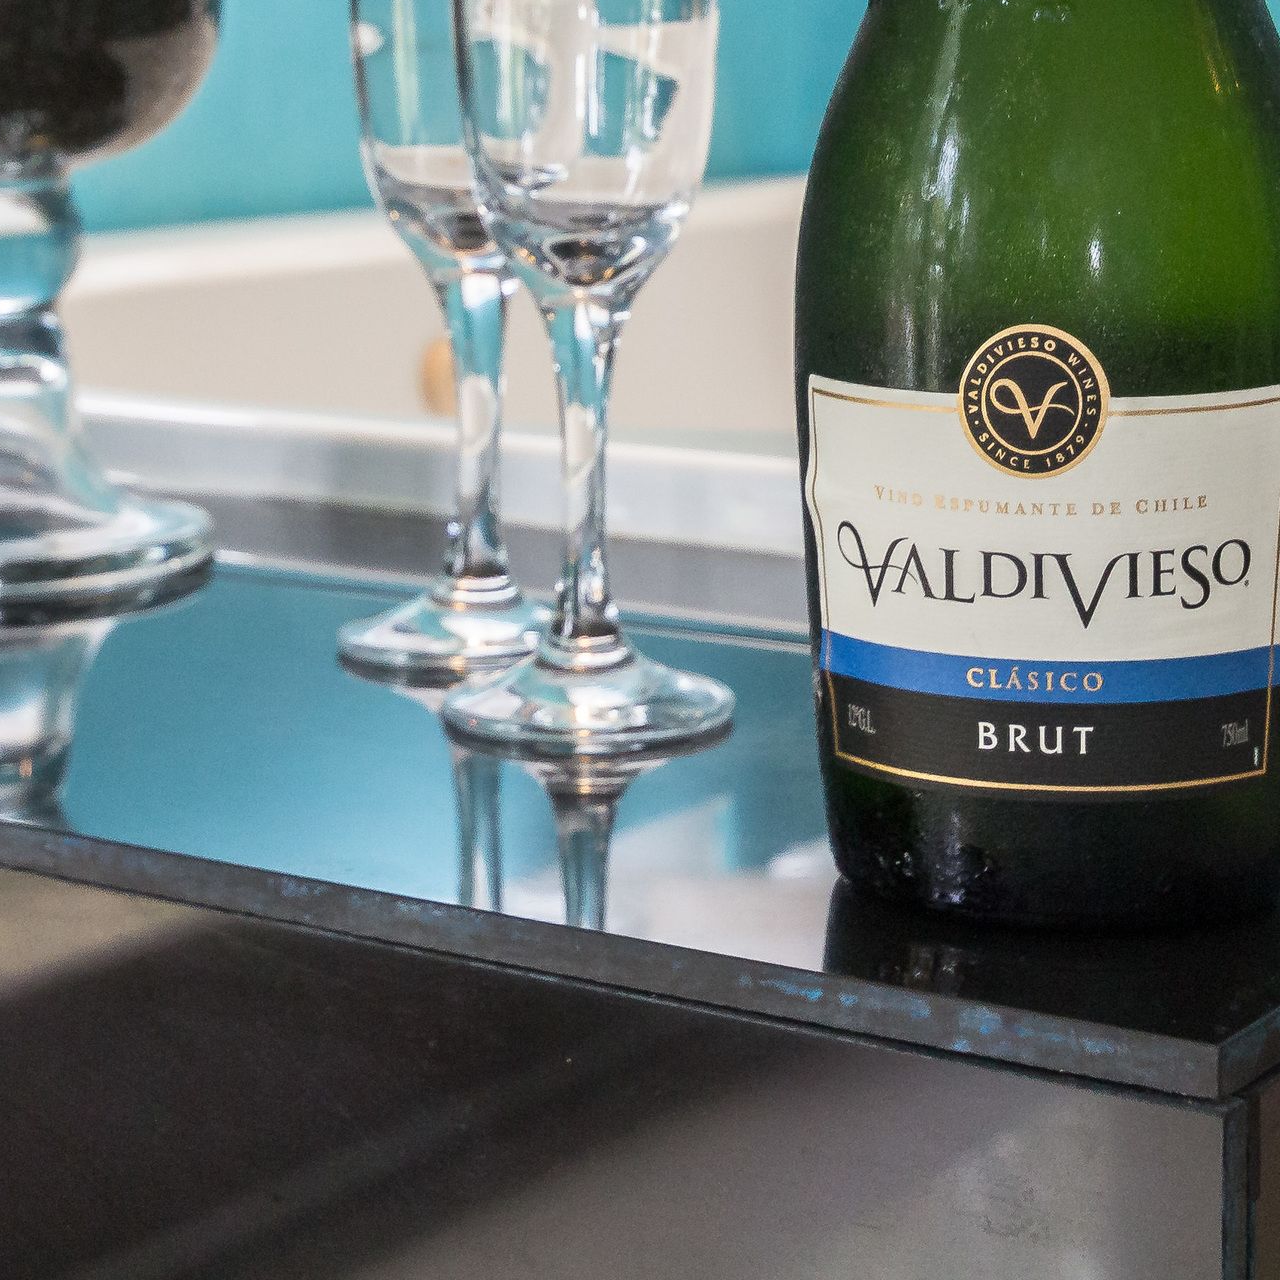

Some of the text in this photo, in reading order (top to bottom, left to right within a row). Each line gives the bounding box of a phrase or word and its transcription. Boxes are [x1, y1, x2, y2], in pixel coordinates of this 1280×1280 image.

[967, 336, 1097, 416] VALDIVIESO WINES
[978, 432, 1085, 470] SINCE 1879
[874, 485, 1208, 516] VINO ESPUMANTE DE CHILE
[837, 520, 1251, 629] VALDIVIESO
[966, 665, 1104, 693] CLÁSICO
[977, 721, 1094, 755] BRUT
